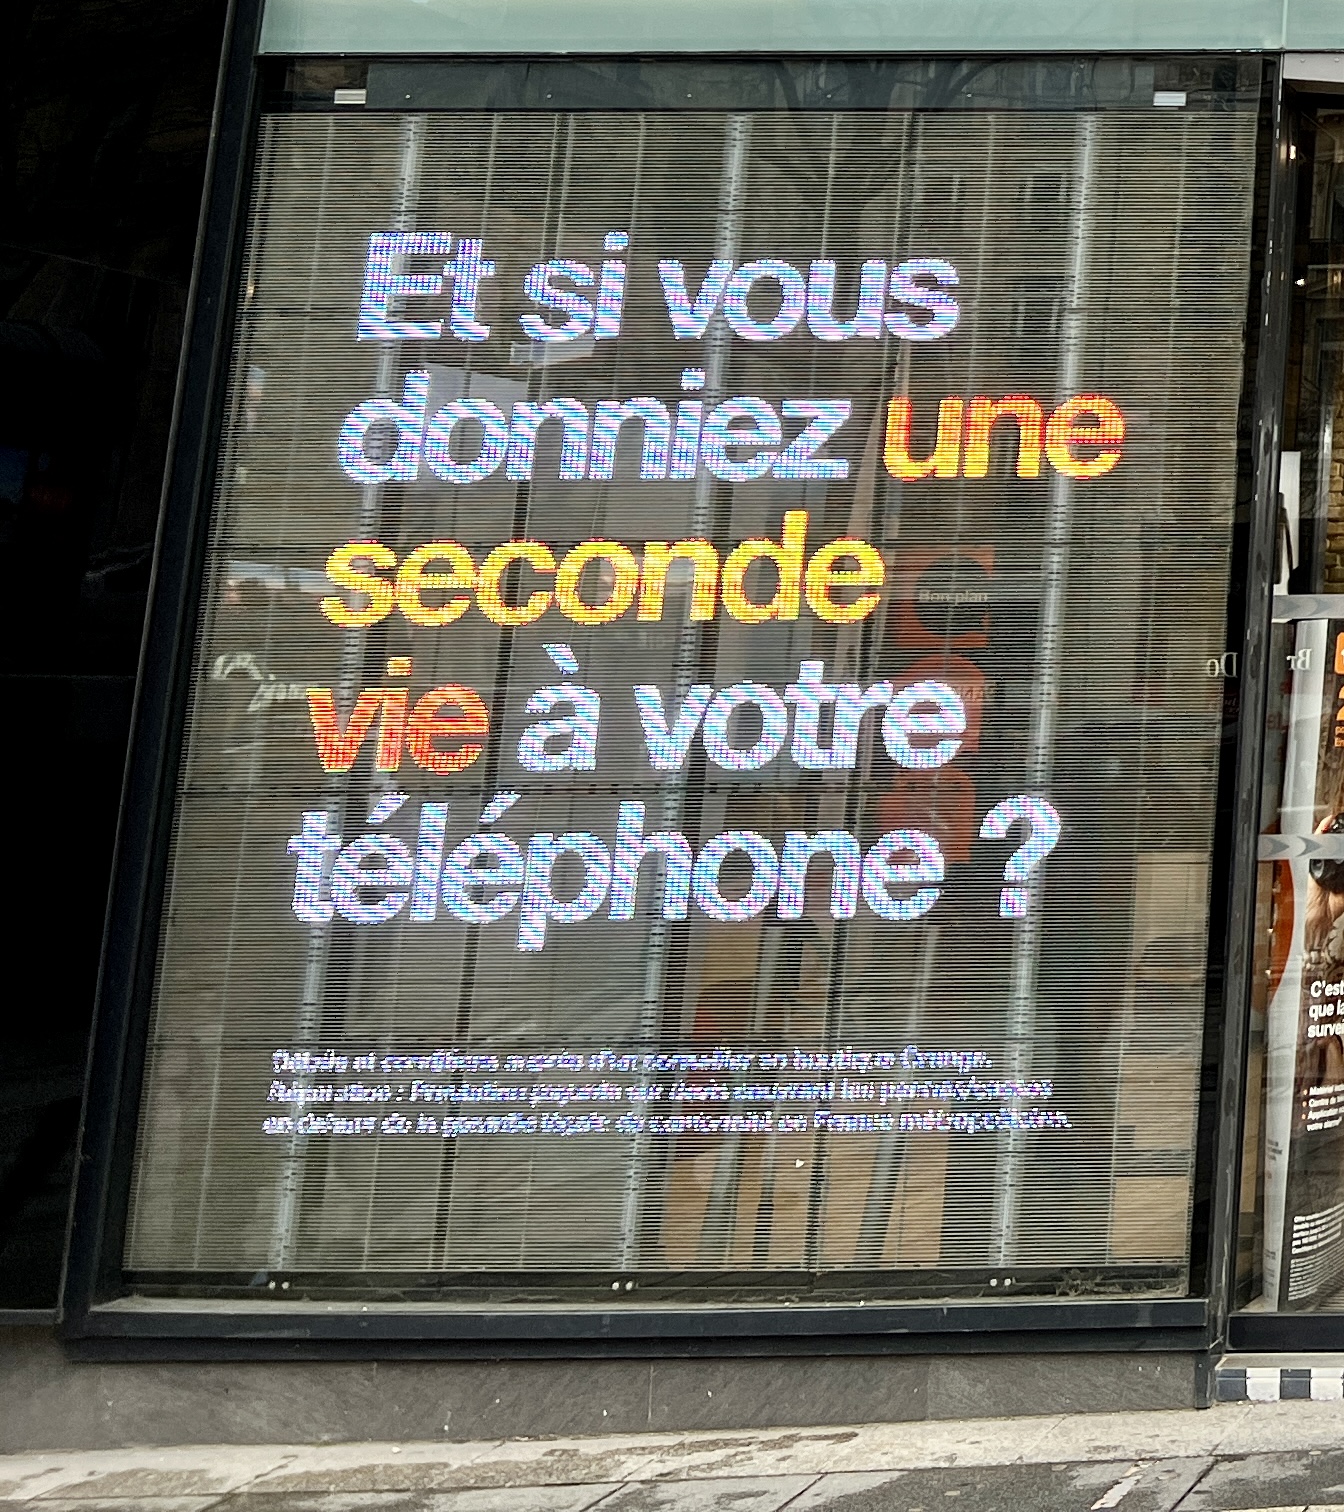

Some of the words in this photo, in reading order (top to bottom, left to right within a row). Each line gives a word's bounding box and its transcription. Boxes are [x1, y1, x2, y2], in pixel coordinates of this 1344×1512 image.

[358, 231, 495, 342] Et
[520, 231, 629, 342] si
[657, 257, 962, 342] vous
[337, 368, 852, 483] donniez
[883, 392, 1126, 479] une
[318, 510, 885, 627] seconde
[306, 656, 490, 774] vie
[516, 643, 599, 772] à
[634, 660, 968, 772] votre
[286, 790, 946, 952] téléphone
[978, 794, 1062, 920] ?
[1309, 1003, 1334, 1022] que
